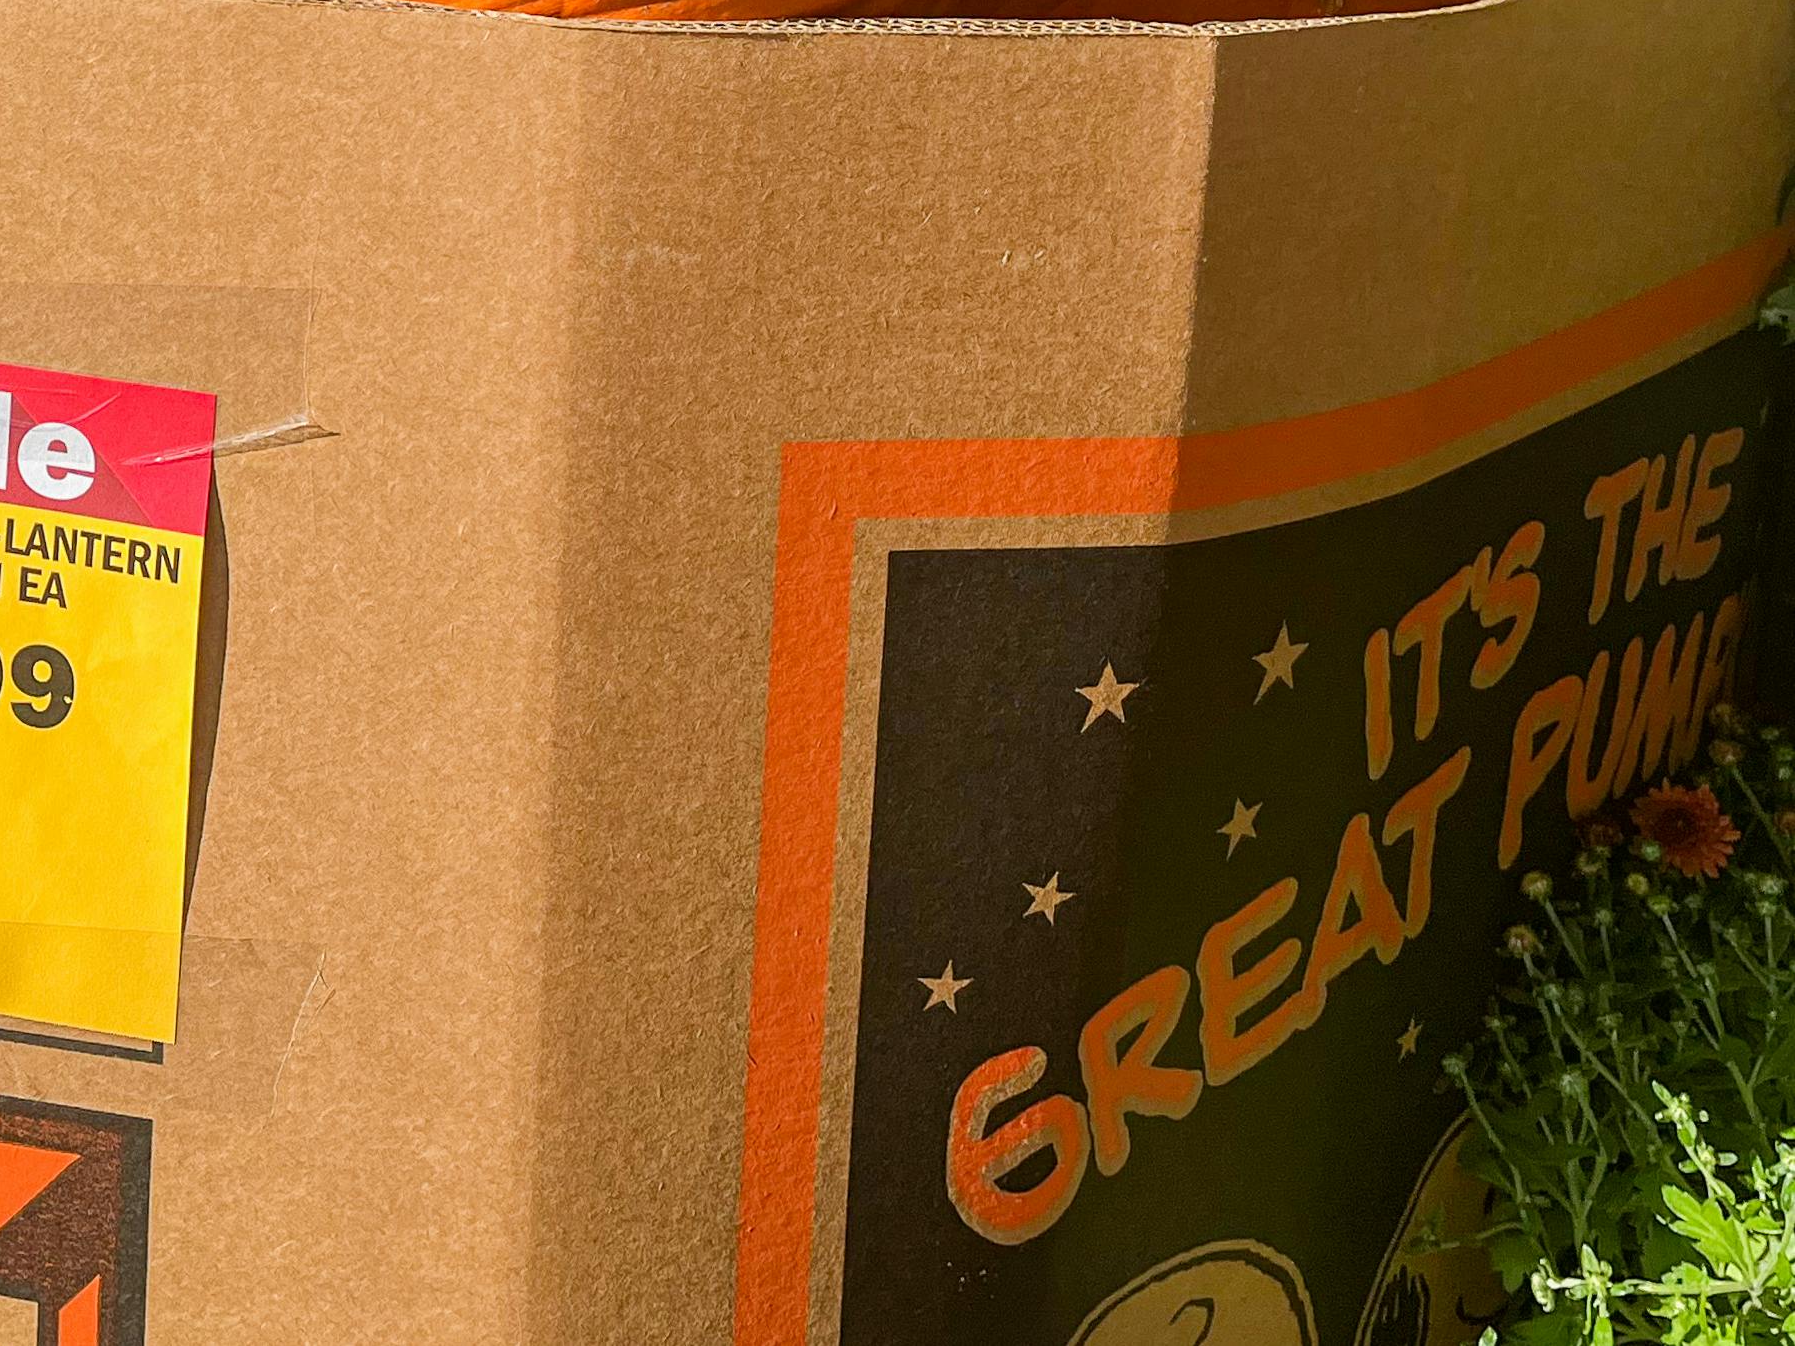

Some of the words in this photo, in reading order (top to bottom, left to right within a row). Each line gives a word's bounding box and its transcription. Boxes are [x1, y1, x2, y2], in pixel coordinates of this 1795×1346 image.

[18, 566, 68, 610] EA
[1363, 519, 1546, 781] IT'S
[1584, 427, 1745, 625] THE
[946, 745, 1474, 1245] GREAT
[1498, 594, 1753, 871] PUMP
